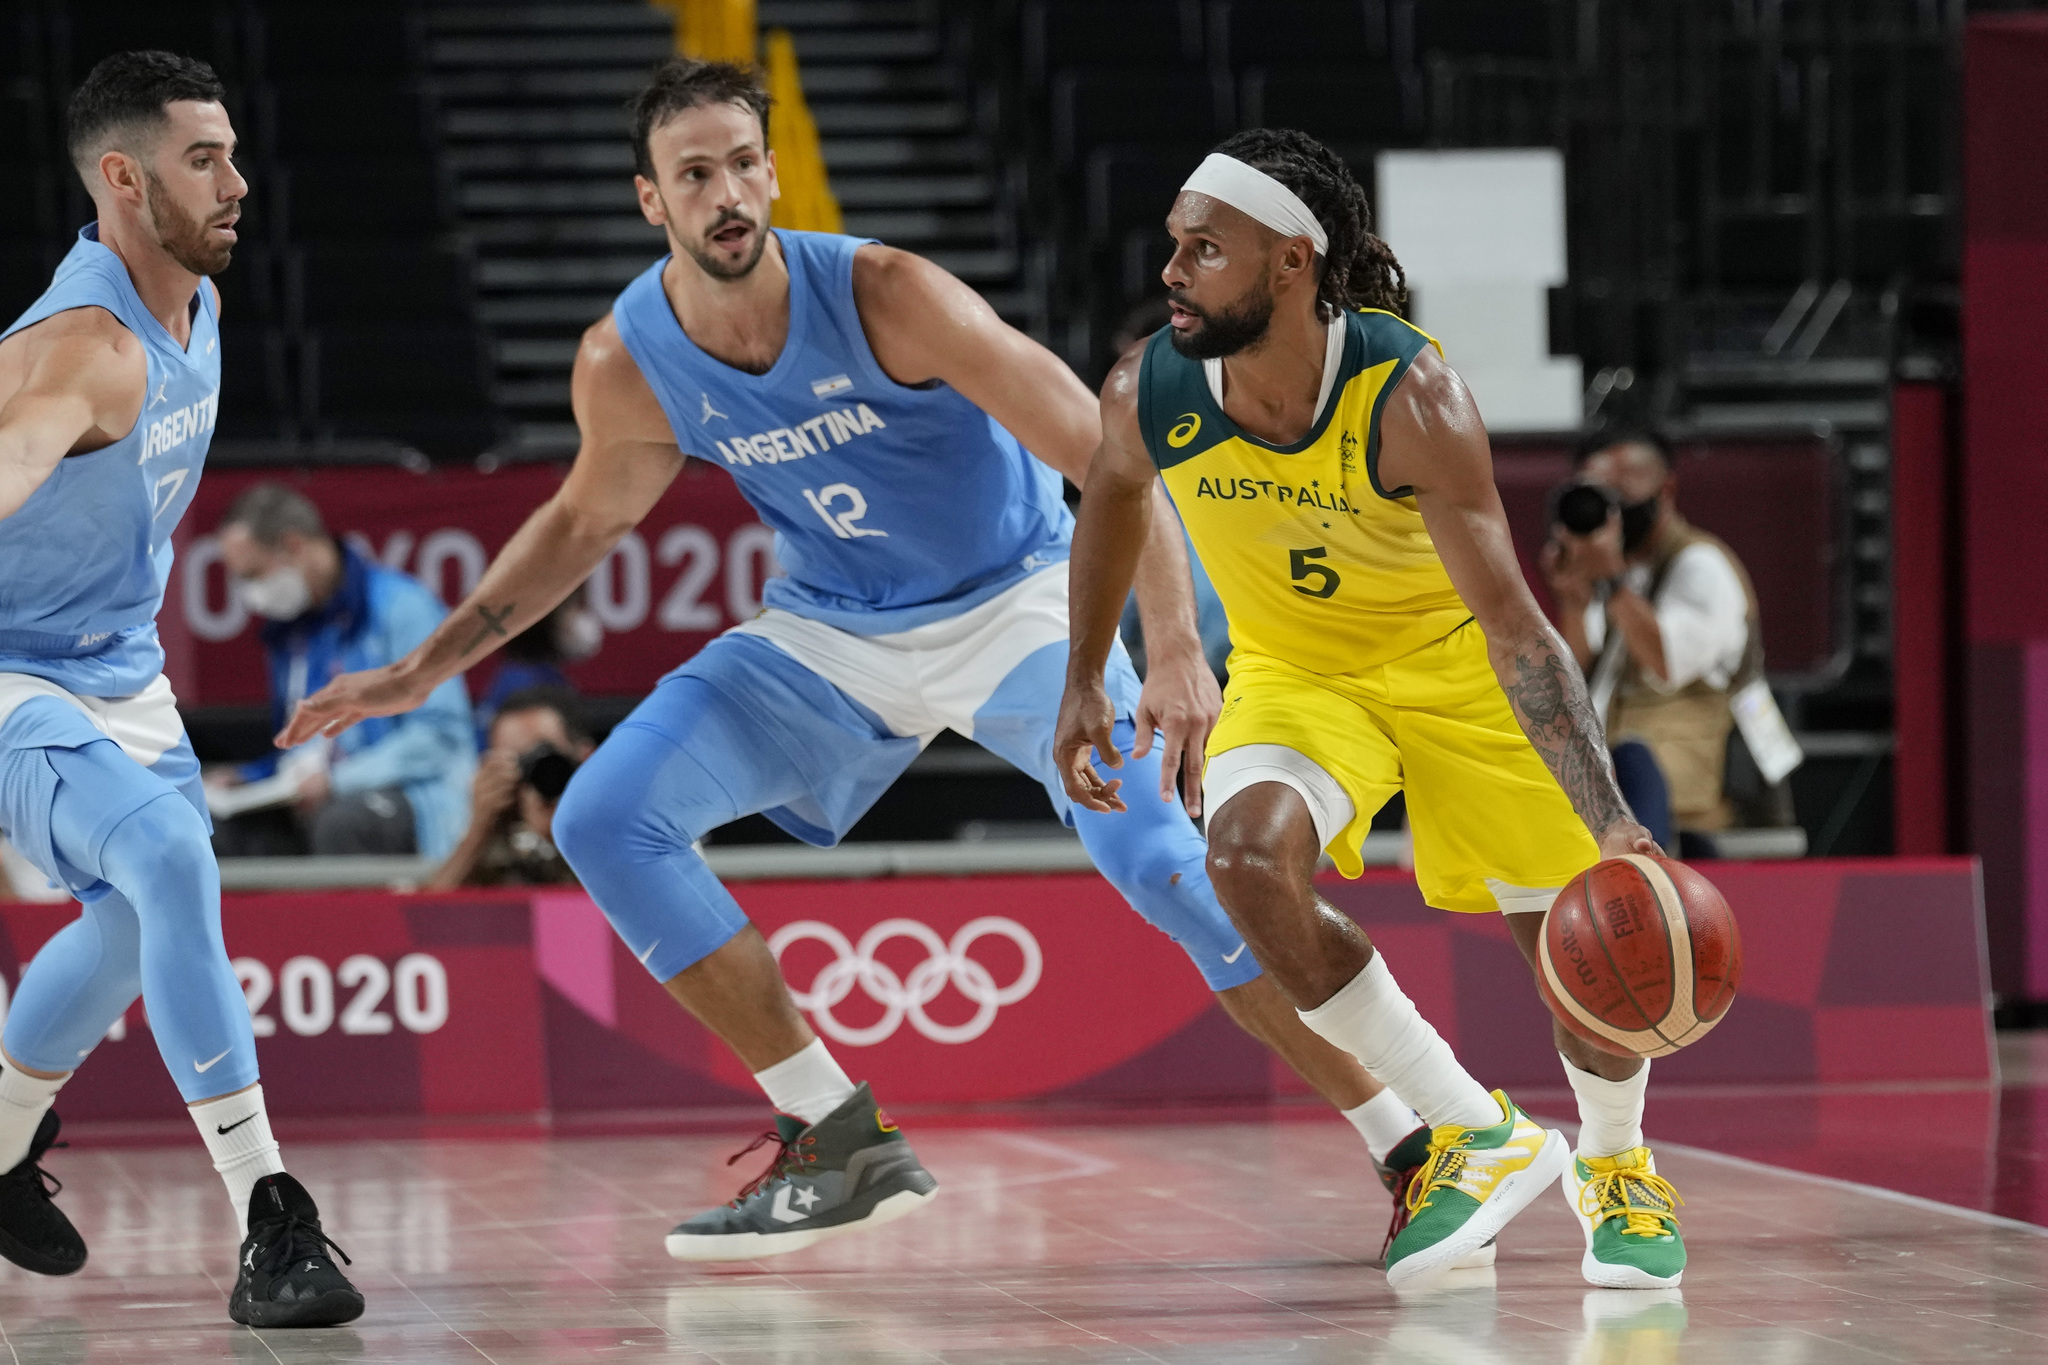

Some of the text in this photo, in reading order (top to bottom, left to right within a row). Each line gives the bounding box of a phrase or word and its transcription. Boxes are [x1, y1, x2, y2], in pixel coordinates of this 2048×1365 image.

[138, 386, 220, 466] ARGENTIN
[716, 402, 886, 466] ARGENTINA
[153, 468, 189, 521] 17
[802, 482, 889, 539] 12
[1197, 476, 1350, 513] AUSTRALIA
[588, 525, 787, 632] 020
[1289, 546, 1341, 599] 5
[1559, 903, 1598, 987] molten
[1604, 896, 1634, 940] FIBA
[230, 953, 449, 1037] 2020
